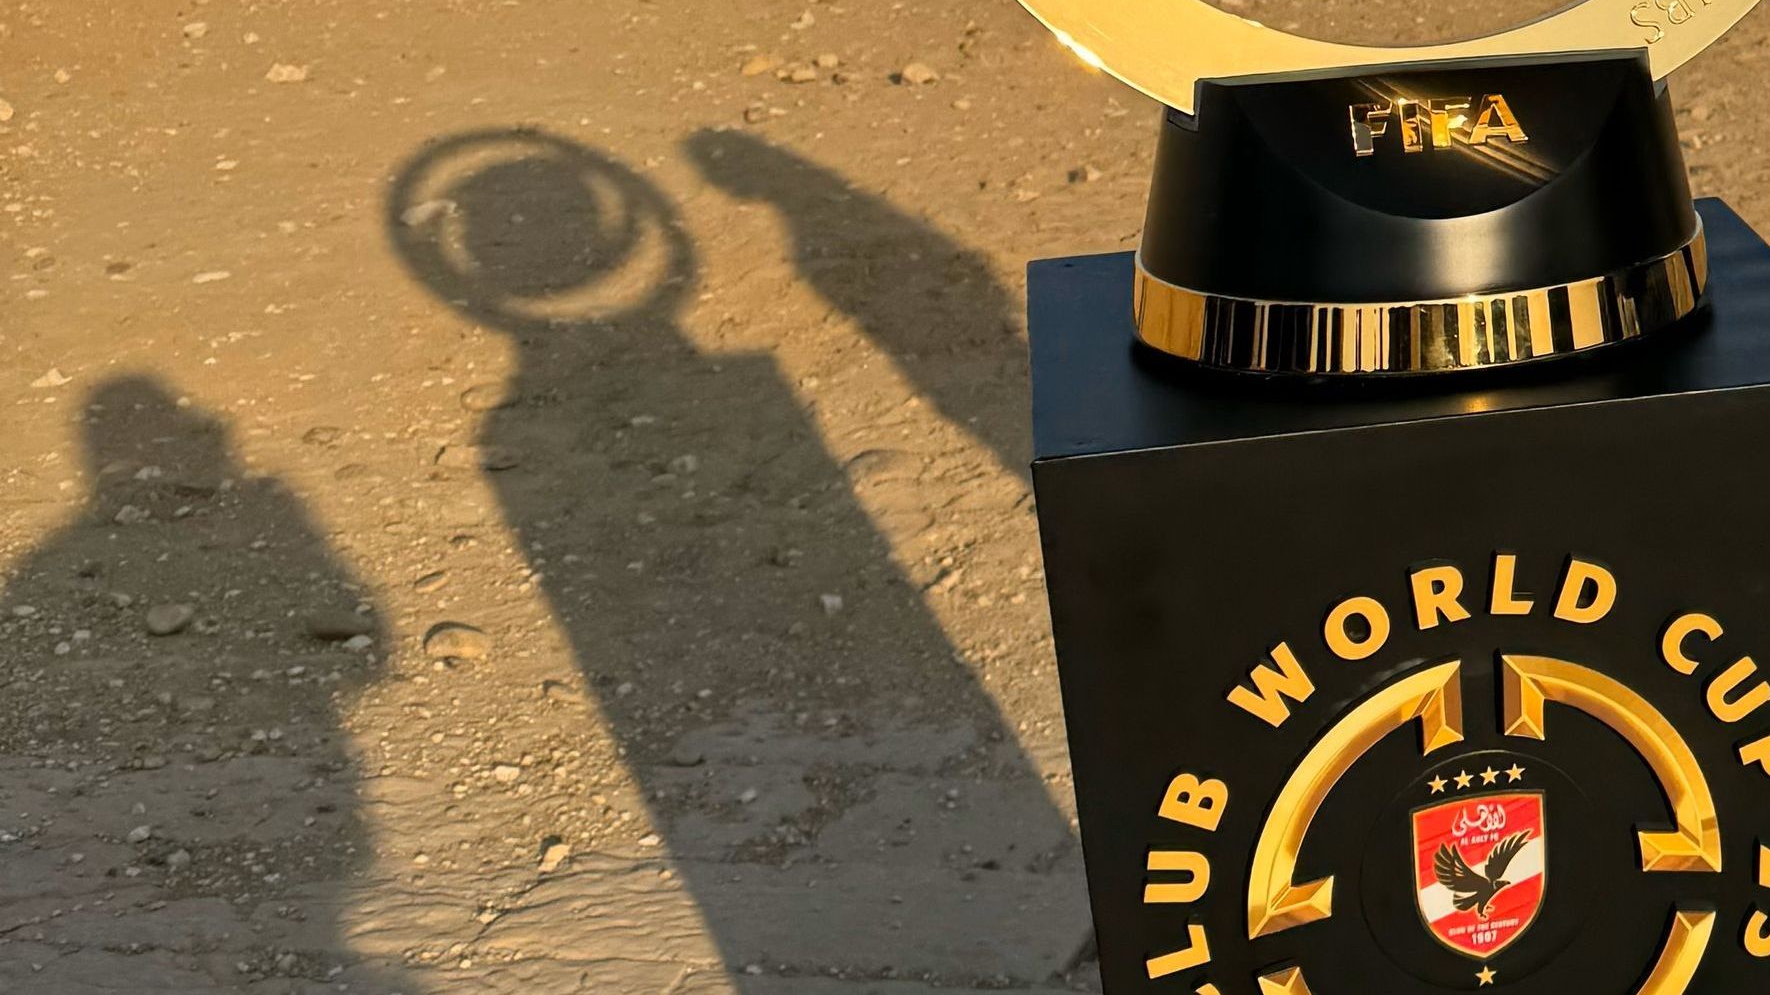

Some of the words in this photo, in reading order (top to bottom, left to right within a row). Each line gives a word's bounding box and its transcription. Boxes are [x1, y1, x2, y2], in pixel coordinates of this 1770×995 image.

[1349, 94, 1529, 157] FIFA
[1144, 773, 1229, 995] LUB
[1226, 554, 1617, 729] WORLD
[1472, 930, 1497, 945] 1907
